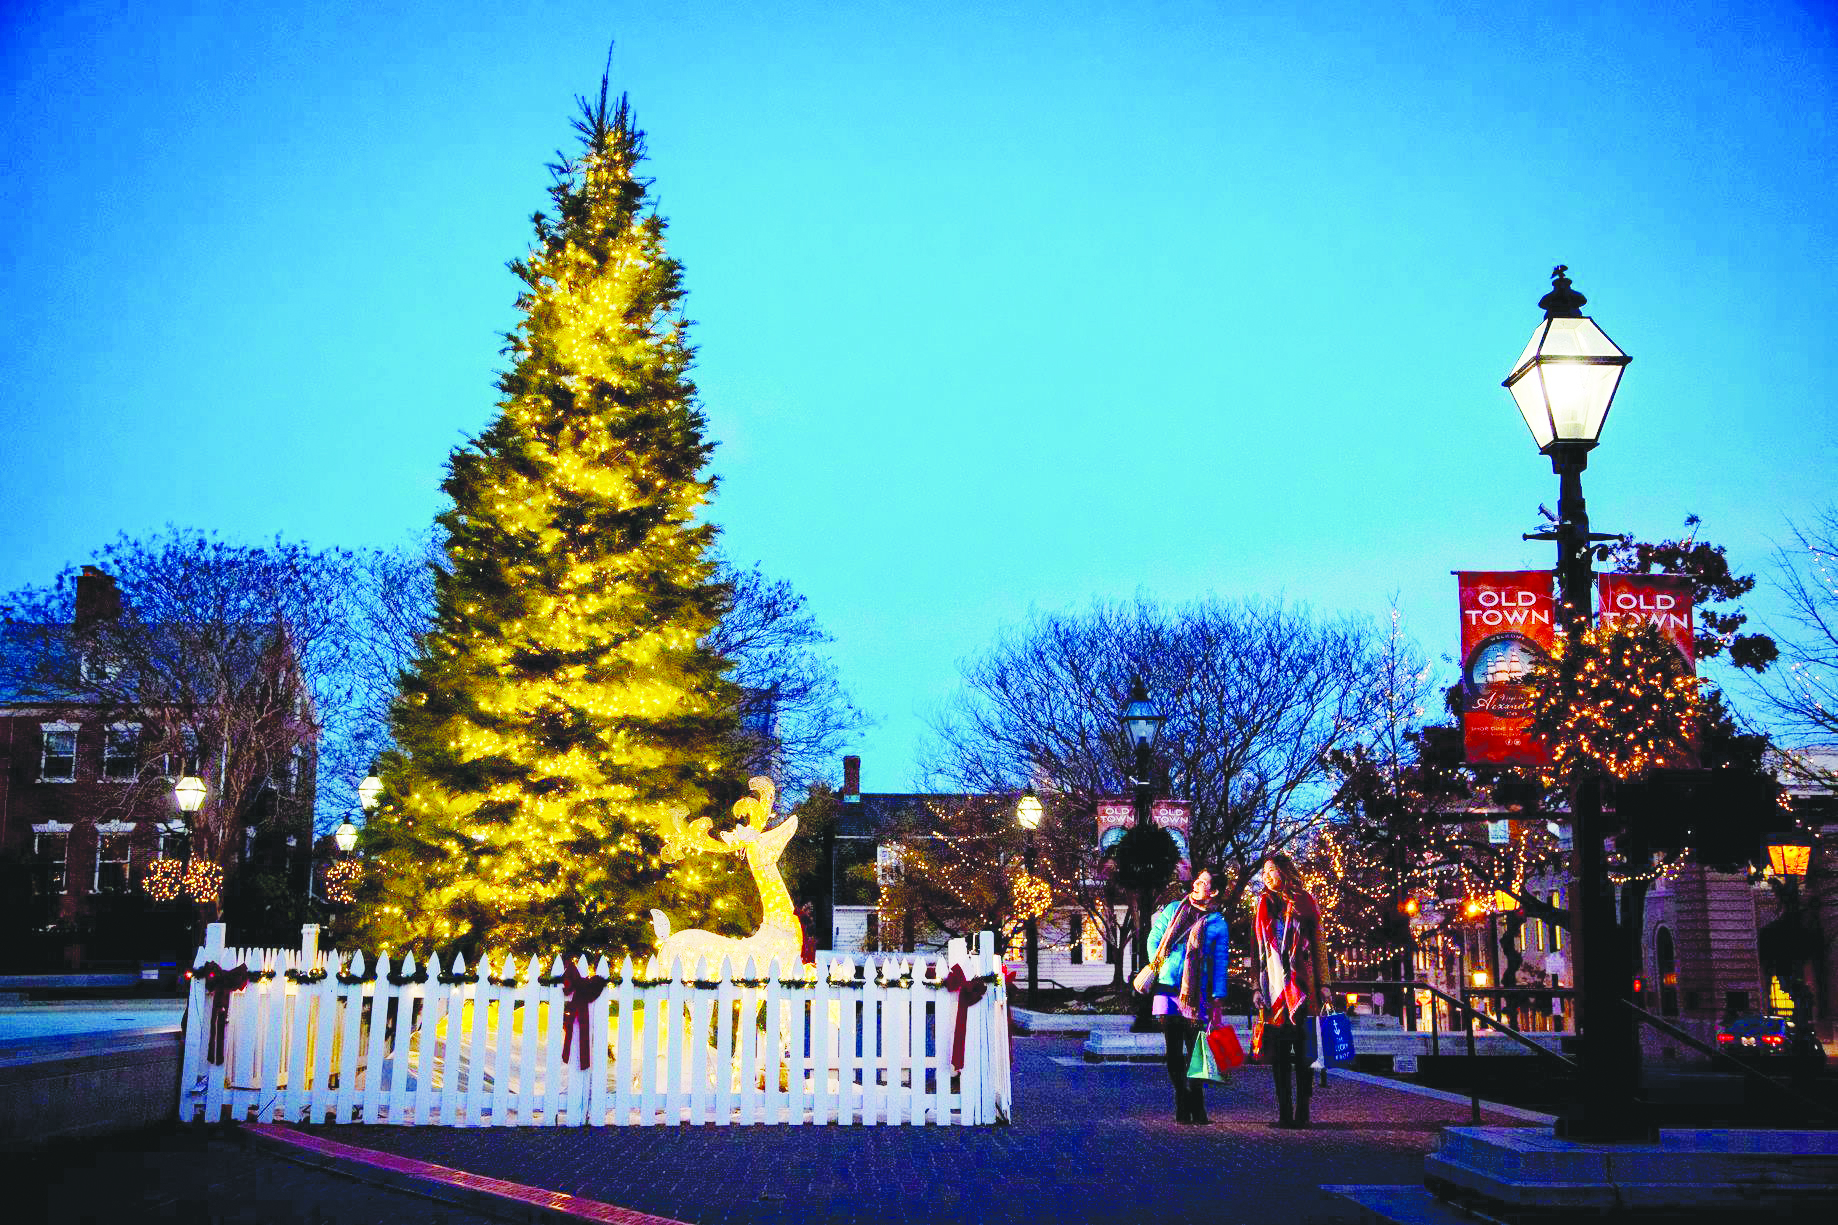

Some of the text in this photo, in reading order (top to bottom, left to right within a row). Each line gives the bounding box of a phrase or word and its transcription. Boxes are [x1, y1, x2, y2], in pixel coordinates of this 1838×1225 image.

[1478, 591, 1537, 607] OLD
[1616, 593, 1676, 610] OLD
[1464, 609, 1550, 626] TOWN
[1105, 807, 1130, 815] OLD
[1159, 808, 1184, 816] OLD
[1100, 815, 1135, 823] TOWN
[1154, 815, 1189, 824] TOWN
